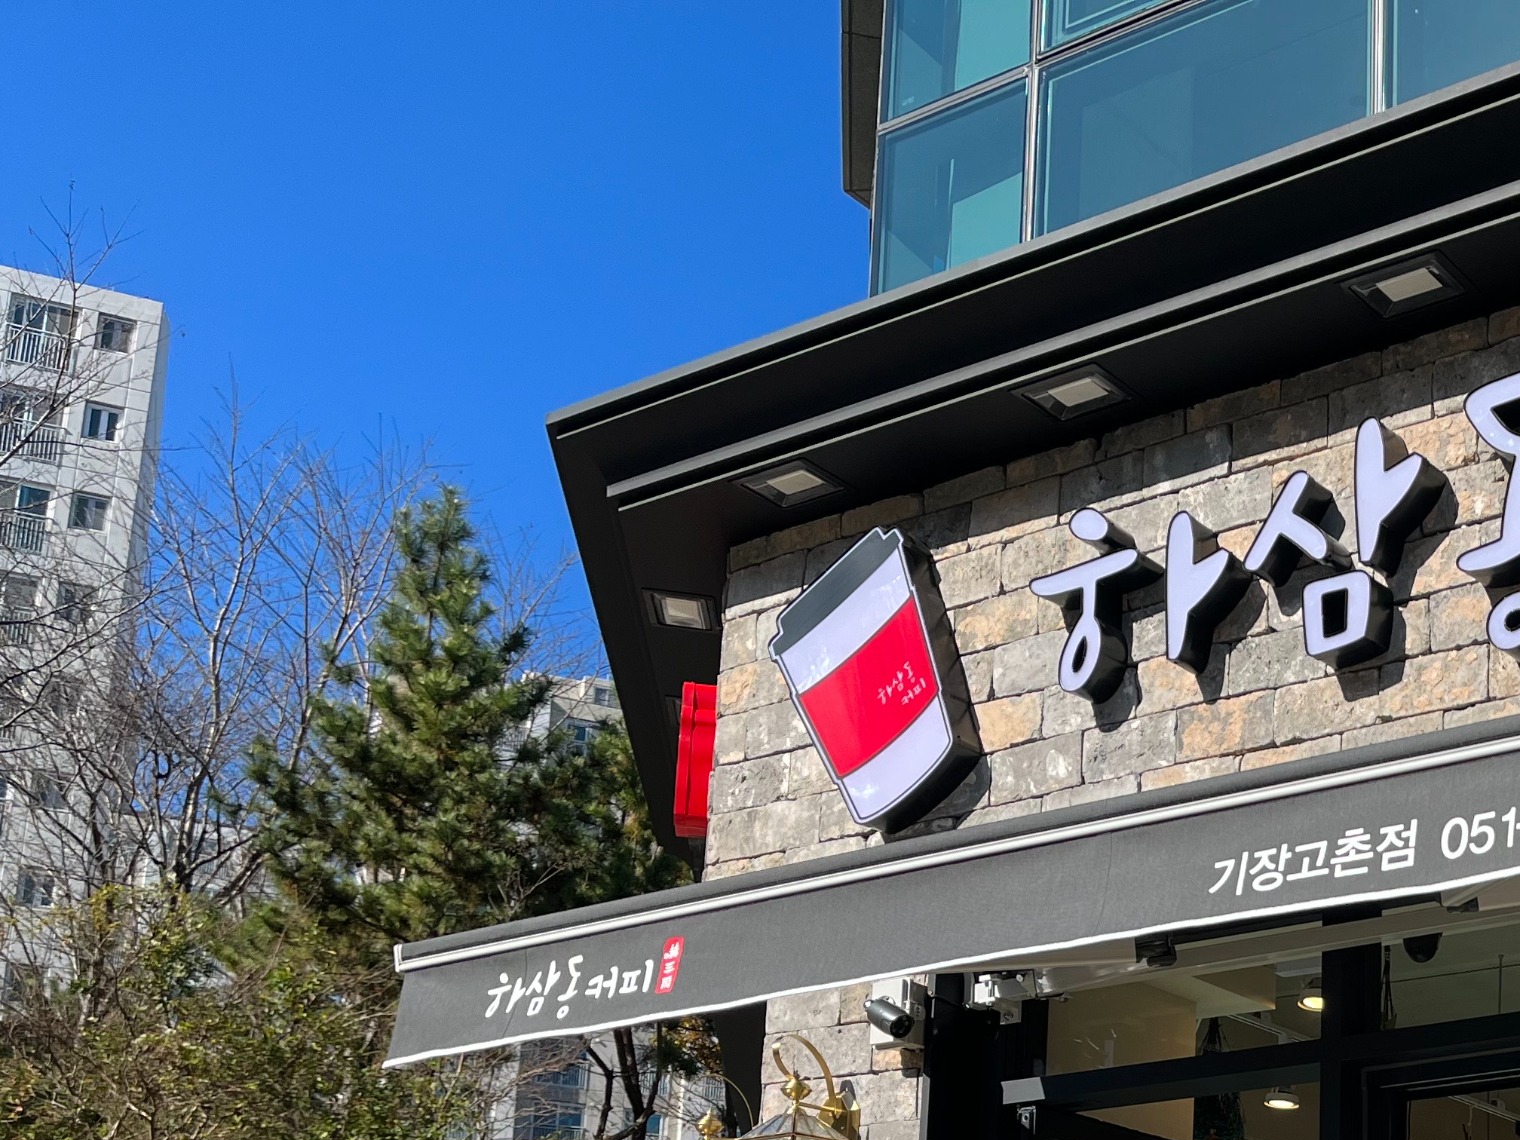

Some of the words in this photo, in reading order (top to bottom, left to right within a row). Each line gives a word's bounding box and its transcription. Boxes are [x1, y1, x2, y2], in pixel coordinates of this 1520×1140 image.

[877, 660, 916, 705] 하삼동
[901, 677, 926, 705] 커피
[1207, 818, 1419, 896] 기장고촌점
